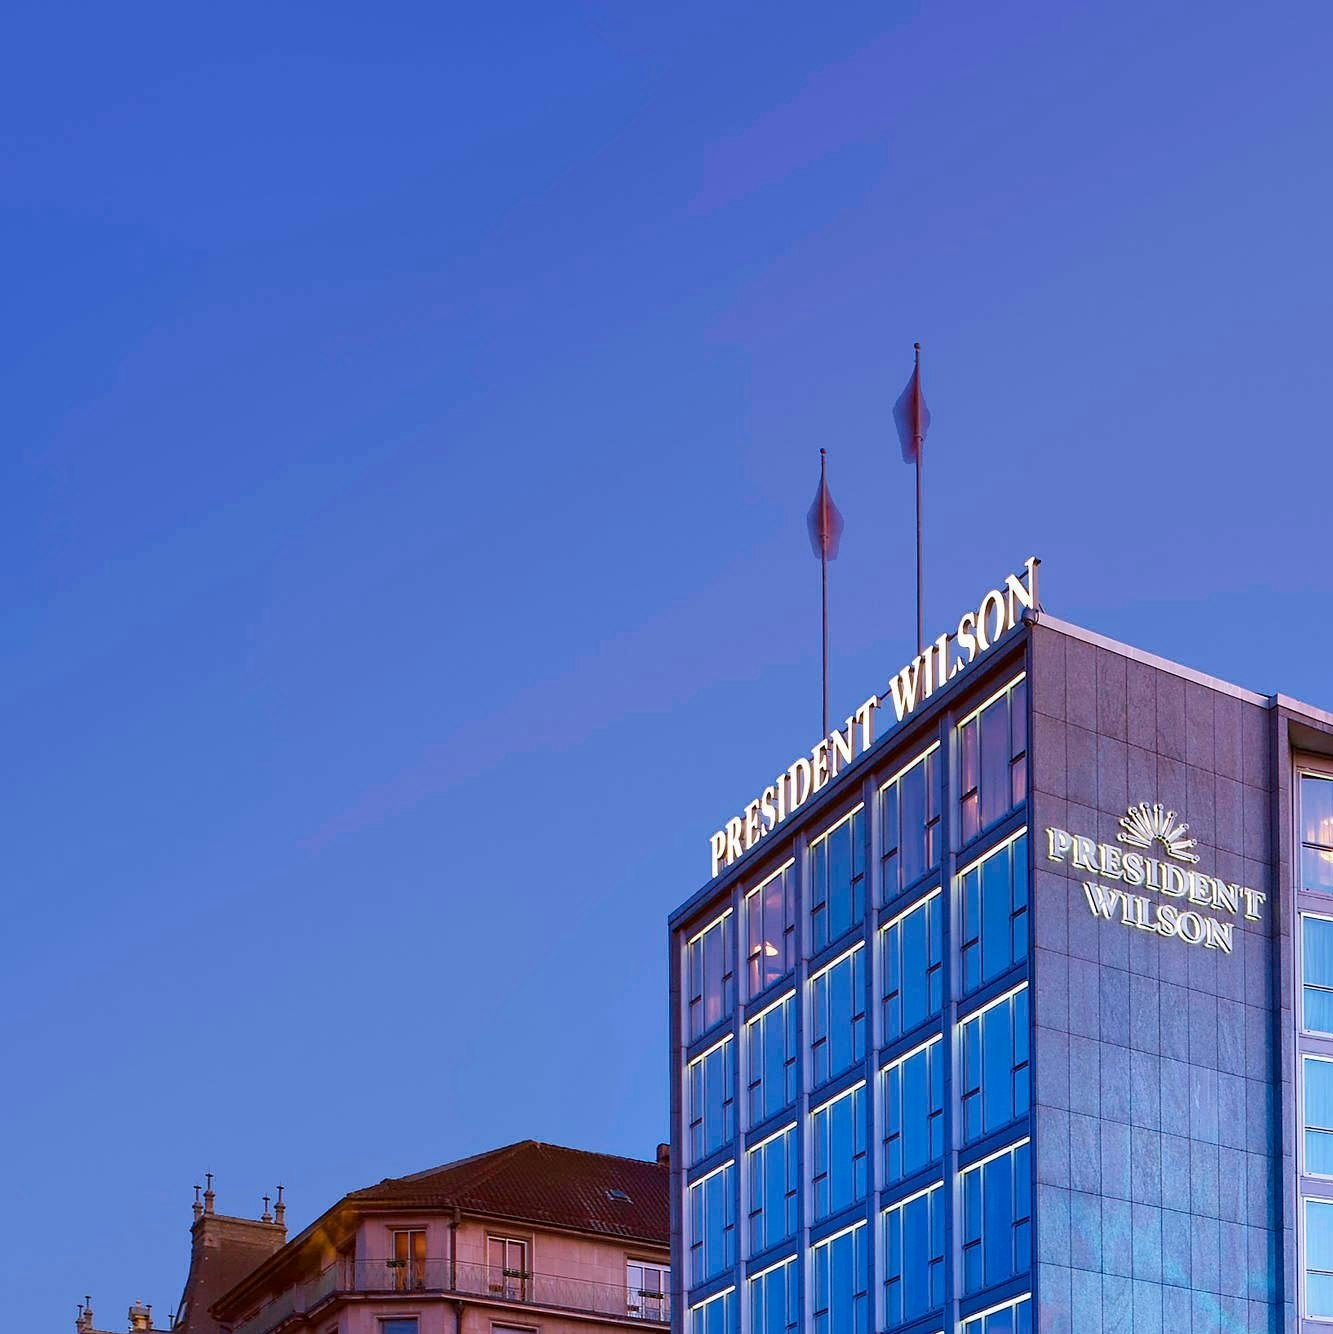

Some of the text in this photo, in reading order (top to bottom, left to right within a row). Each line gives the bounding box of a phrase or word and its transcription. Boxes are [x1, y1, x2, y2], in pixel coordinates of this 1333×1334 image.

[710, 556, 1039, 878] PRESIDENT WILSON
[1046, 826, 1266, 921] PRESIDENT
[1083, 881, 1234, 954] WILSON
